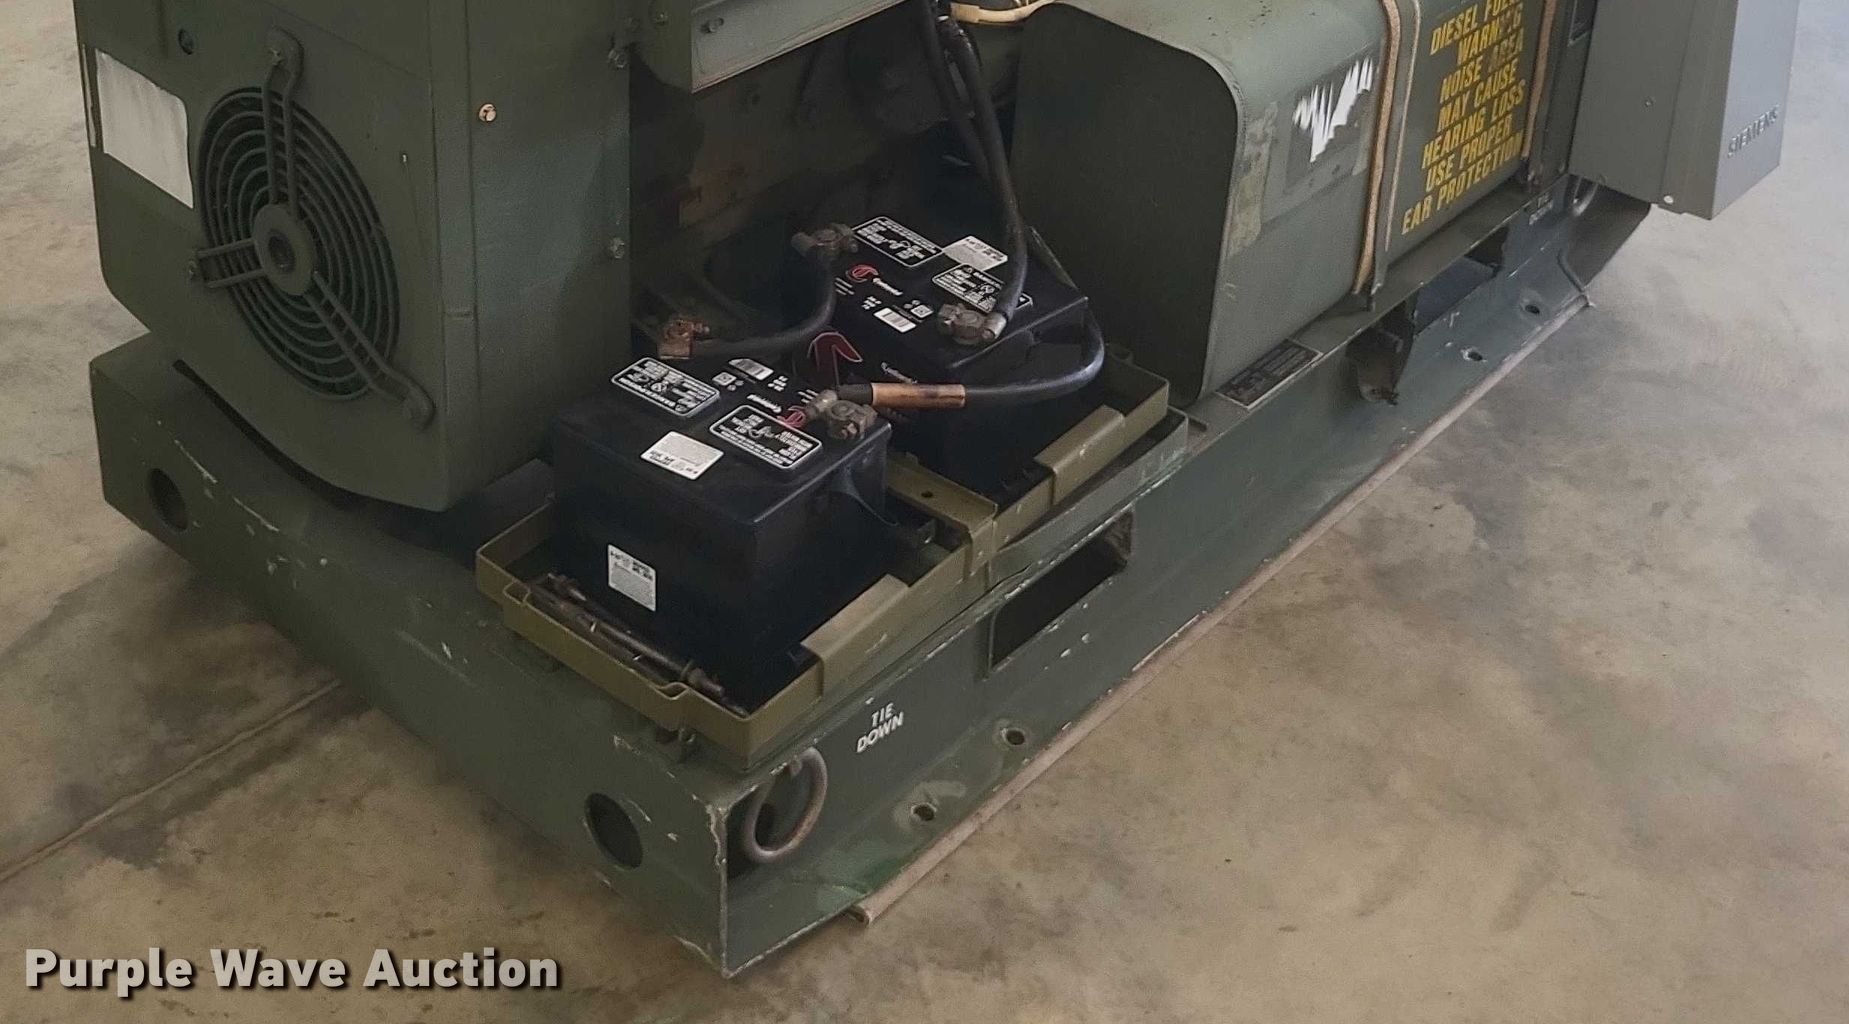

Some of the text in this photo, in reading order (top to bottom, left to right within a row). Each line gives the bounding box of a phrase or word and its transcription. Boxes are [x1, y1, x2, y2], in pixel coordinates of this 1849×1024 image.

[1430, 4, 1478, 55] DIESEL
[1437, 58, 1518, 133] MAY CAUSE
[1440, 55, 1482, 104] NOISE
[1421, 79, 1526, 169] HEARING LOSS
[1426, 114, 1513, 192] USE PROPER
[1402, 195, 1433, 235] EAR
[1437, 129, 1524, 211] PROTECTION
[857, 711, 904, 753] DOWN
[871, 702, 894, 727] TIE
